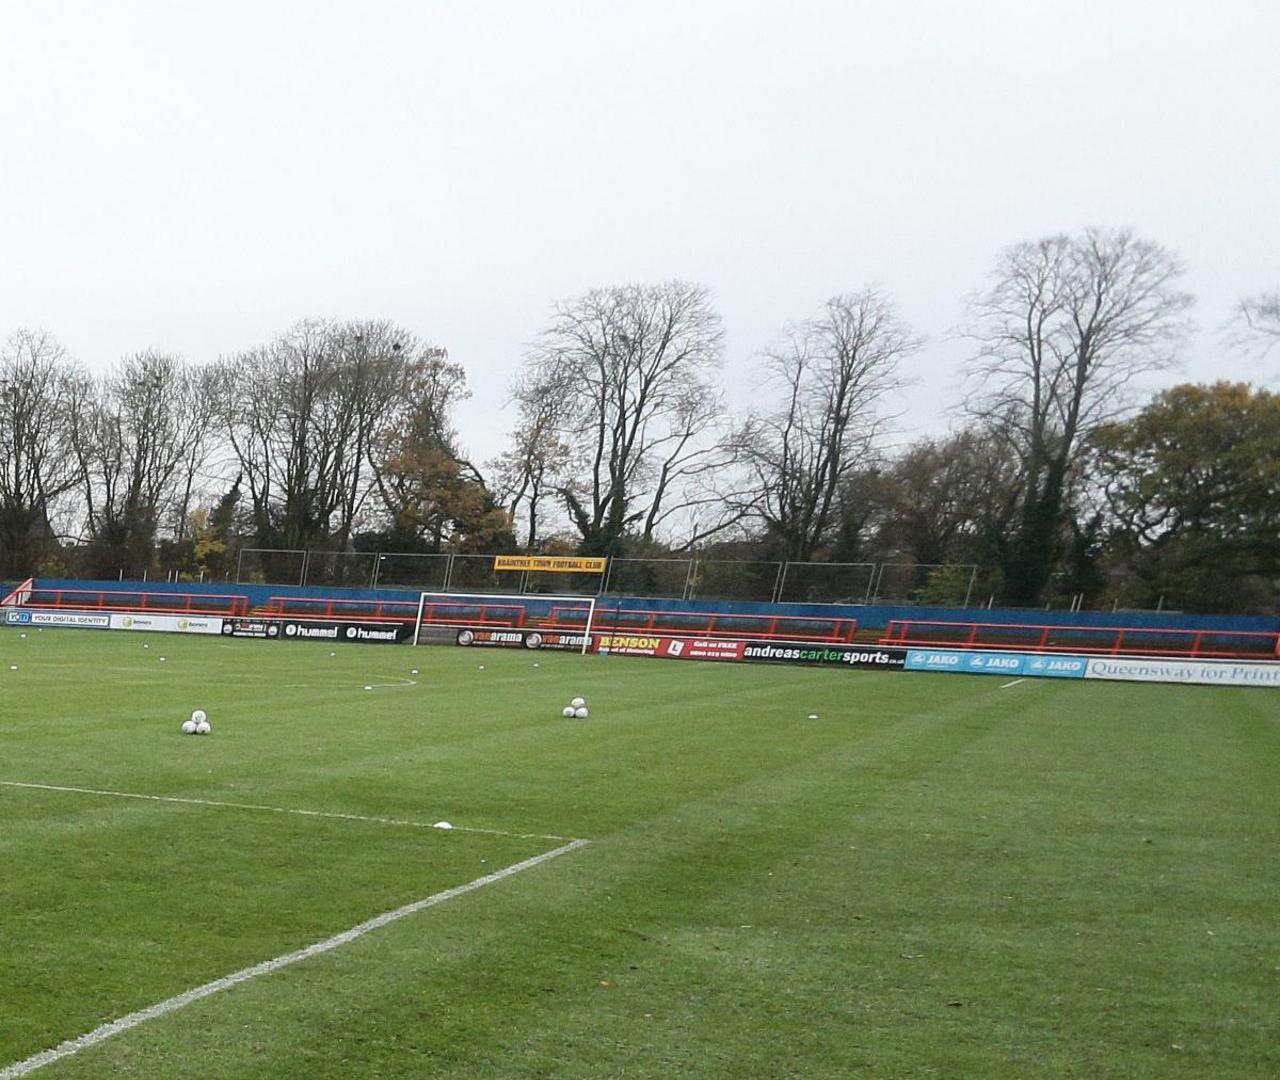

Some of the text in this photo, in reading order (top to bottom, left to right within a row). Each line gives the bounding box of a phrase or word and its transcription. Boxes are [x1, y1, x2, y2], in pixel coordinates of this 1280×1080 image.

[78, 617, 107, 625] IDENTITY
[297, 625, 338, 638] hummel
[358, 628, 397, 640] hummel
[474, 631, 523, 642] vanarama
[600, 636, 661, 648] BENSON
[927, 655, 958, 665] JAKO
[985, 657, 1019, 668] JAKO
[1047, 661, 1081, 671] JAKO
[1092, 661, 1280, 682] Queensway for Print
